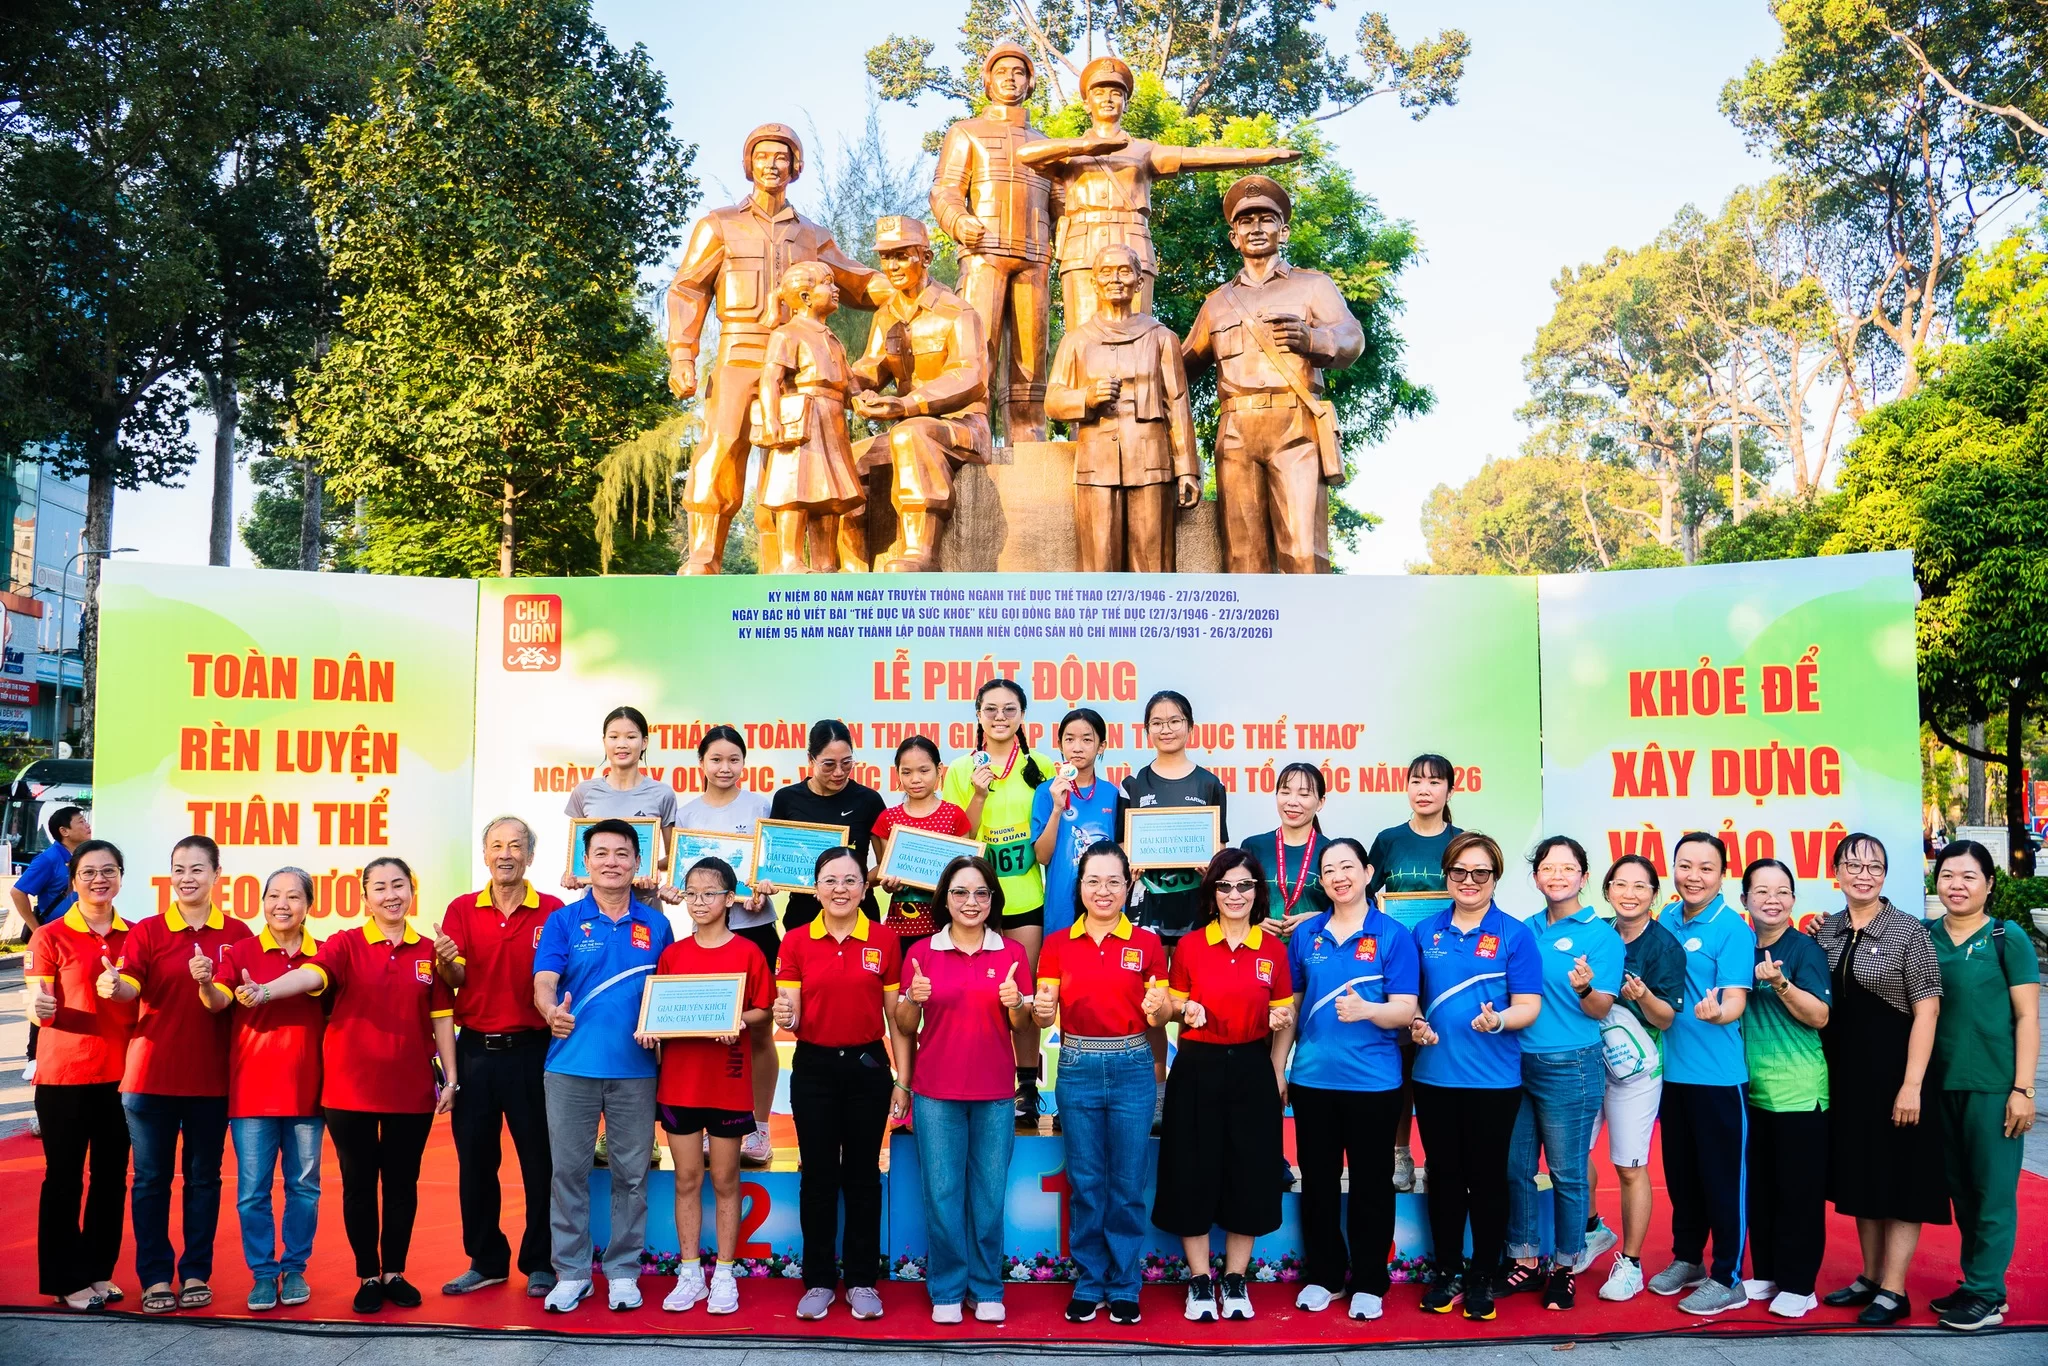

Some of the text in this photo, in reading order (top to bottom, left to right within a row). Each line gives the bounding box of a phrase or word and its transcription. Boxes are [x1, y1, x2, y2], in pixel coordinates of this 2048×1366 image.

[515, 600, 550, 623] CHỢ
[732, 608, 760, 620] NGÀY
[762, 607, 784, 620] BÁC
[786, 606, 800, 620] HỒ
[804, 606, 826, 620] VIẾT
[830, 607, 846, 620] BÀI
[876, 609, 898, 622] DỤC
[902, 607, 916, 620] VÀ
[918, 607, 940, 620] SỨC
[978, 606, 998, 619] KÊU
[1002, 609, 1020, 621] GỌI
[1022, 605, 1052, 619] ĐỒNG
[1054, 606, 1076, 619] BÀO
[1078, 606, 1098, 621] TẬP
[1102, 604, 1120, 619] THỂ
[1124, 608, 1146, 621] DỤC
[1150, 608, 1208, 619] (27/3/1946
[1218, 608, 1280, 619] 27/3/2026)
[784, 589, 810, 604] NIỆM
[814, 592, 828, 602] 80
[830, 589, 854, 602] NĂM
[856, 589, 884, 602] NGÀY
[888, 587, 926, 602] TRUYỀN
[930, 587, 964, 602] THỐNG
[968, 588, 1004, 601] NGÀNH
[1006, 586, 1026, 601] THỂ
[1030, 590, 1052, 603] DỤC
[1054, 586, 1074, 601] THỂ
[1076, 590, 1104, 601] THAO
[1106, 590, 1166, 601] (27/3/1946
[1176, 590, 1240, 601] 27/3/2026),
[509, 620, 557, 643] QUÁN
[754, 625, 780, 640] NIỆM
[784, 628, 798, 638] 95
[800, 625, 824, 638] NĂM
[828, 625, 854, 638] NGÀY
[858, 625, 892, 638] THÀNH
[896, 625, 914, 640] LẬP
[916, 625, 946, 638] ĐOÀN
[948, 627, 984, 638] THANH
[986, 624, 1010, 638] NIÊN
[1014, 624, 1042, 640] CỘNG
[1044, 624, 1066, 638] SẢN
[1068, 623, 1084, 638] HỒ
[1086, 624, 1106, 638] CHÍ
[1108, 626, 1136, 638] MINH
[1140, 626, 1200, 638] (26/3/1931
[1210, 626, 1272, 638] 26/3/2026)
[188, 649, 394, 703] TOÀN DÂN
[873, 649, 1137, 708] LỄ PHÁT ĐỘNG
[1629, 645, 1820, 718] KHỎE ĐỂ
[180, 721, 398, 782] RÈN LUYỆN
[744, 719, 806, 749] TOÀN
[871, 722, 940, 749] THAM
[1243, 714, 1287, 749] THỂ
[533, 762, 595, 792] NGÀY
[672, 766, 774, 793] OLYPIC
[1245, 758, 1276, 793] TỔ
[1612, 741, 1841, 806] XÂY DỰNG
[187, 789, 388, 845] THÂN THỂ
[1608, 824, 1668, 878] VÀ
[1684, 819, 1774, 878] ẢO
[151, 875, 260, 919] TEO
[733, 1182, 772, 1258] 2
[1039, 1166, 1073, 1258] 1
